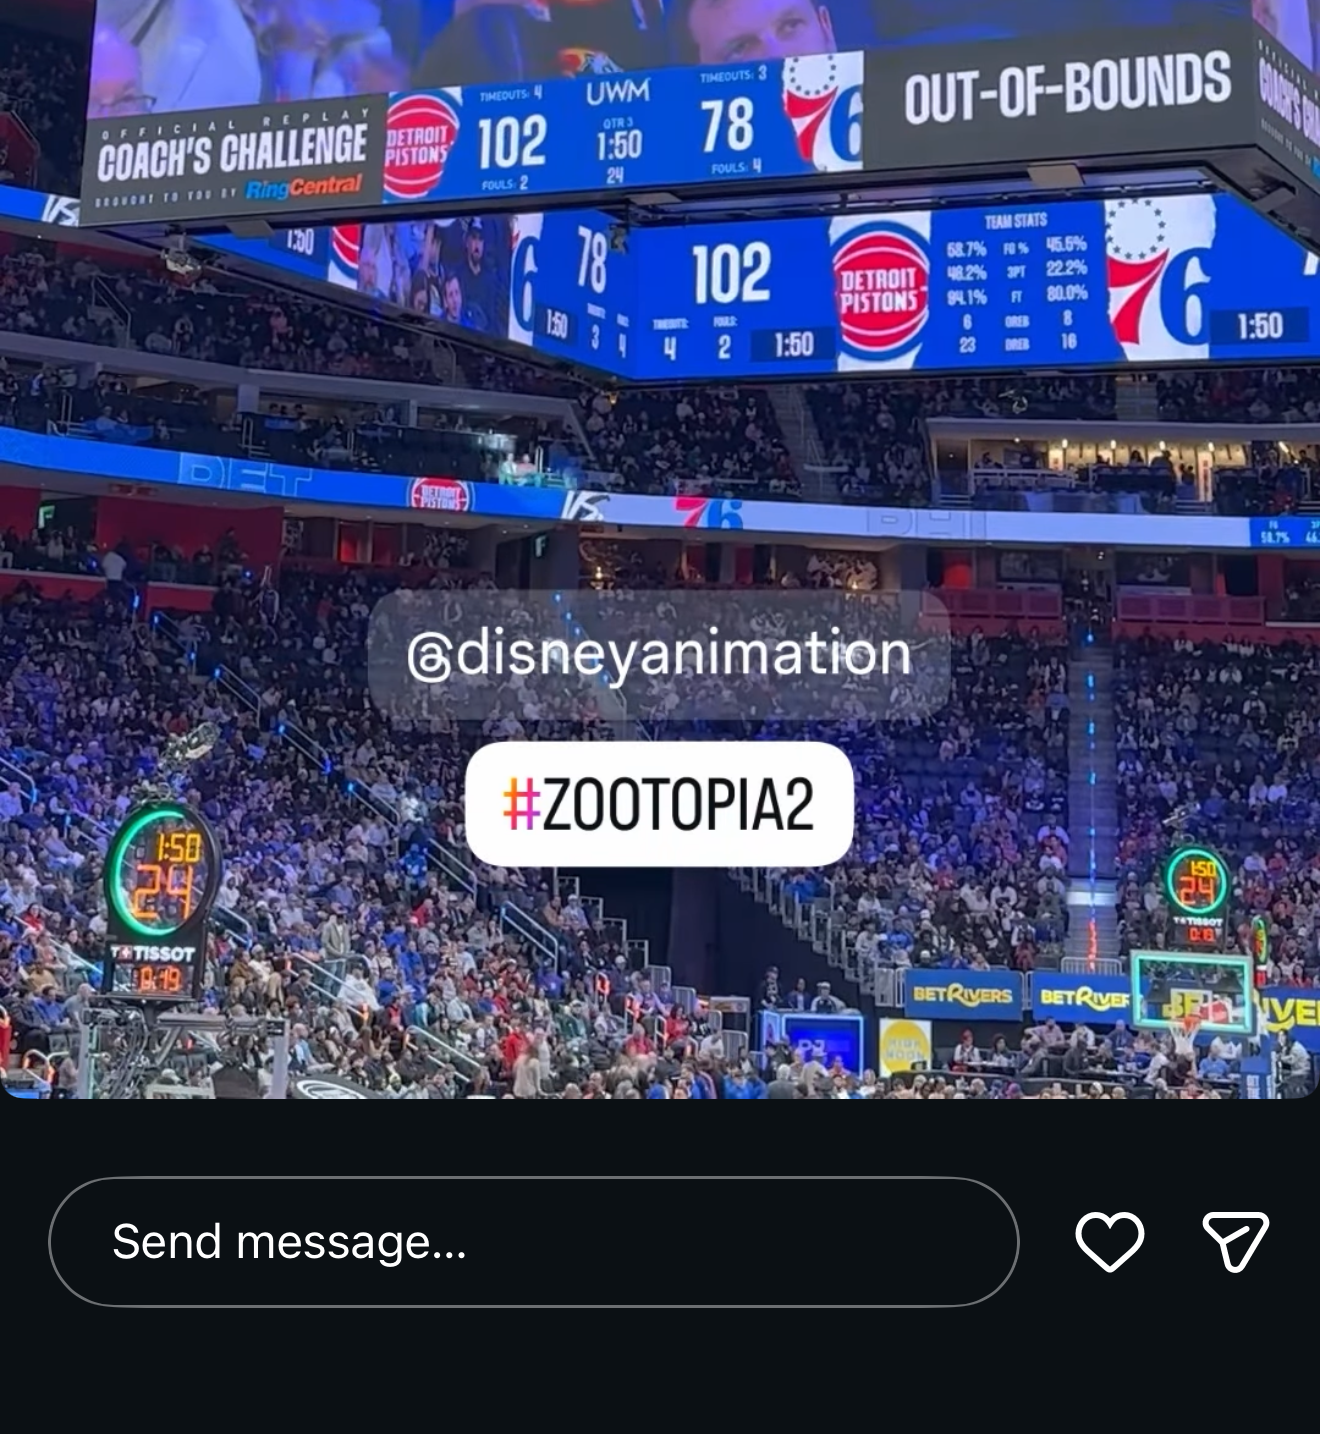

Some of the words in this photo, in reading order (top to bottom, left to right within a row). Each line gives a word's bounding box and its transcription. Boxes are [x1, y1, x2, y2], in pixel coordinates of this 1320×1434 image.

[700, 69, 754, 84] TIMEOUTS:
[758, 64, 767, 81] 3
[905, 49, 1232, 125] OUT-OF-BOUNDS
[480, 90, 529, 102] TIMEOUTS:
[533, 84, 543, 99] 4
[586, 77, 651, 106] UWM
[101, 119, 235, 141] OFFICIAL
[262, 107, 369, 127] REPLAY
[386, 124, 449, 148] DETROIT
[603, 118, 626, 130] QTR
[700, 96, 754, 153] 78
[97, 136, 212, 183] COACH'S
[219, 122, 368, 172] CHALLENGE
[478, 113, 548, 170] 102
[597, 128, 642, 161] 1:50
[384, 144, 448, 167] PISTONS
[711, 163, 749, 175] FOULS:
[752, 157, 762, 174] 4
[244, 173, 363, 202] RingCentral
[482, 179, 516, 191] FOULS:
[519, 174, 529, 191] 2
[606, 166, 624, 185] 24
[985, 215, 1012, 230] TEAM
[1014, 212, 1048, 228] STATS
[578, 225, 608, 294] 78
[692, 241, 771, 304] 102
[1007, 266, 1026, 279] 3PT
[841, 267, 917, 291] DETROIT
[841, 290, 918, 314] PISTONS
[1011, 291, 1022, 303] FT
[1107, 247, 1212, 346] 76
[546, 308, 568, 339] 1:50
[963, 314, 972, 330] 6
[1237, 312, 1284, 340] 1:50
[591, 324, 600, 350] 3
[618, 333, 627, 359] 4
[664, 337, 677, 361] 4
[718, 335, 731, 359] 2
[775, 332, 814, 357] 1:50
[959, 337, 976, 353] 23
[1061, 333, 1077, 349] 16
[674, 496, 744, 529] 76
[157, 832, 201, 863] 1:50
[133, 864, 194, 920] 24
[1180, 876, 1215, 905] 24
[133, 946, 196, 962] TISSOT
[913, 982, 1013, 1008] BETRIVERS
